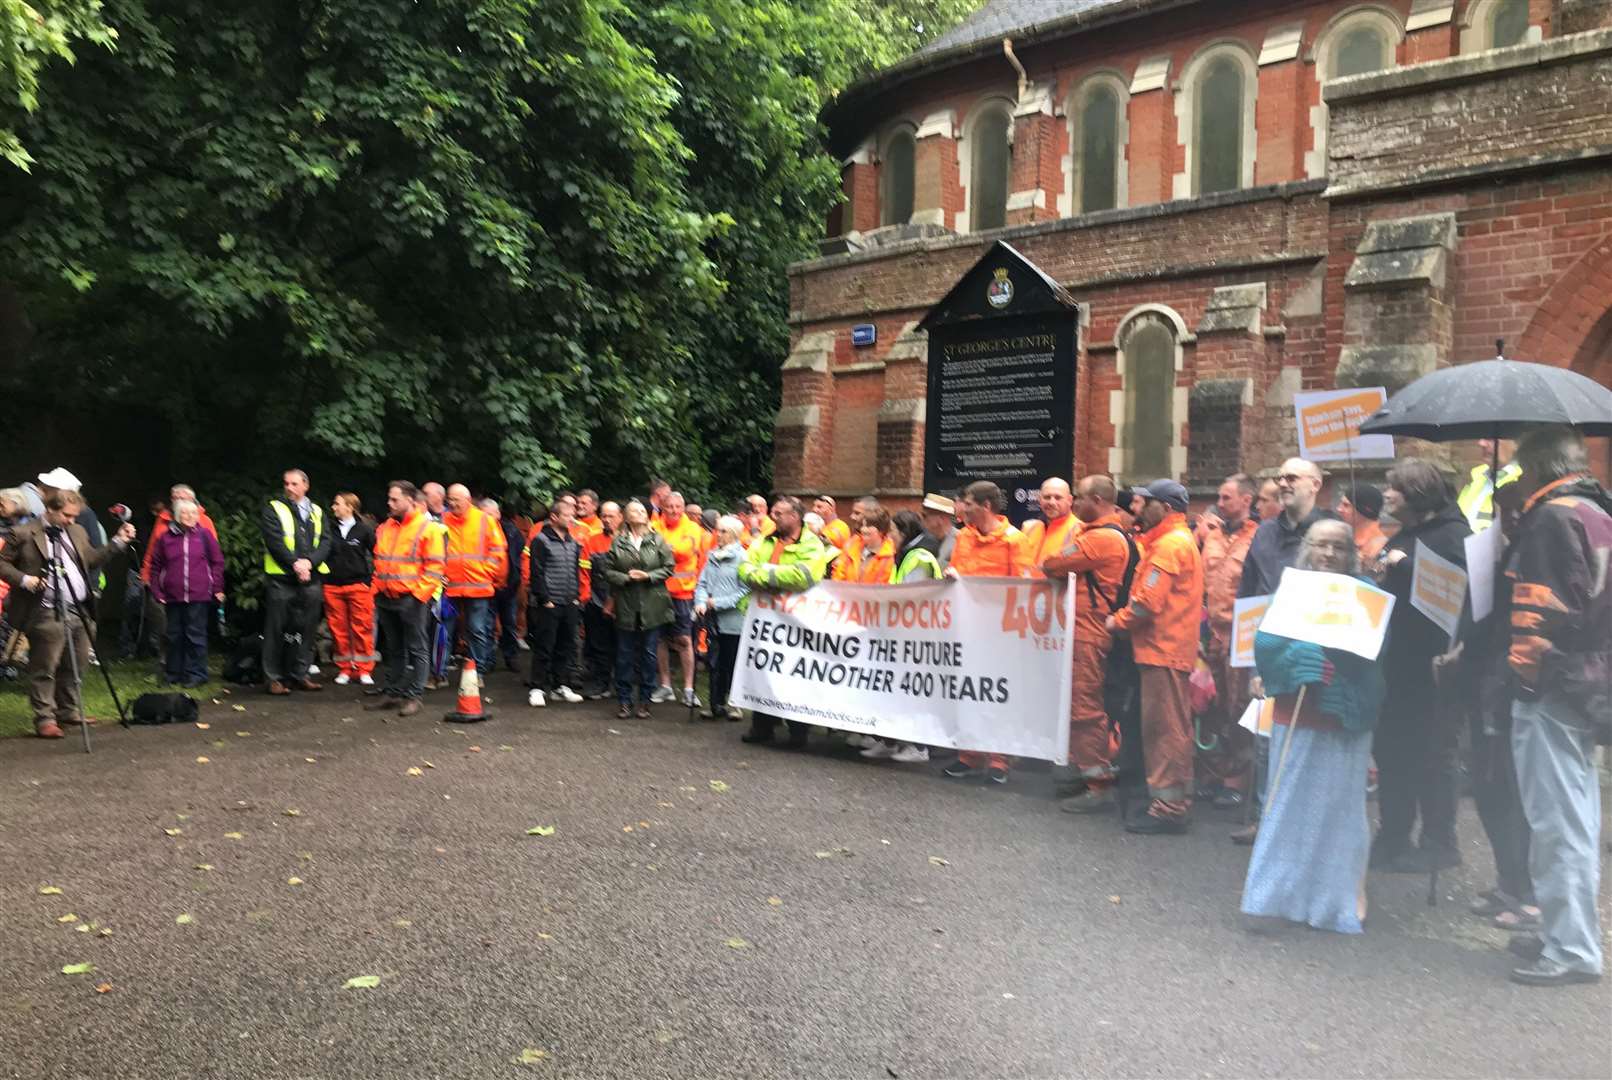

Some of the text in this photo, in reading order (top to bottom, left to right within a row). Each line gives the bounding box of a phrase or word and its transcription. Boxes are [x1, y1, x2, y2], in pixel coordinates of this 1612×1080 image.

[887, 599, 952, 629] DOCKS
[750, 618, 963, 667] SECURING THE FUTURE
[746, 647, 1010, 704] FOR ANOTHER 400 YEARS
